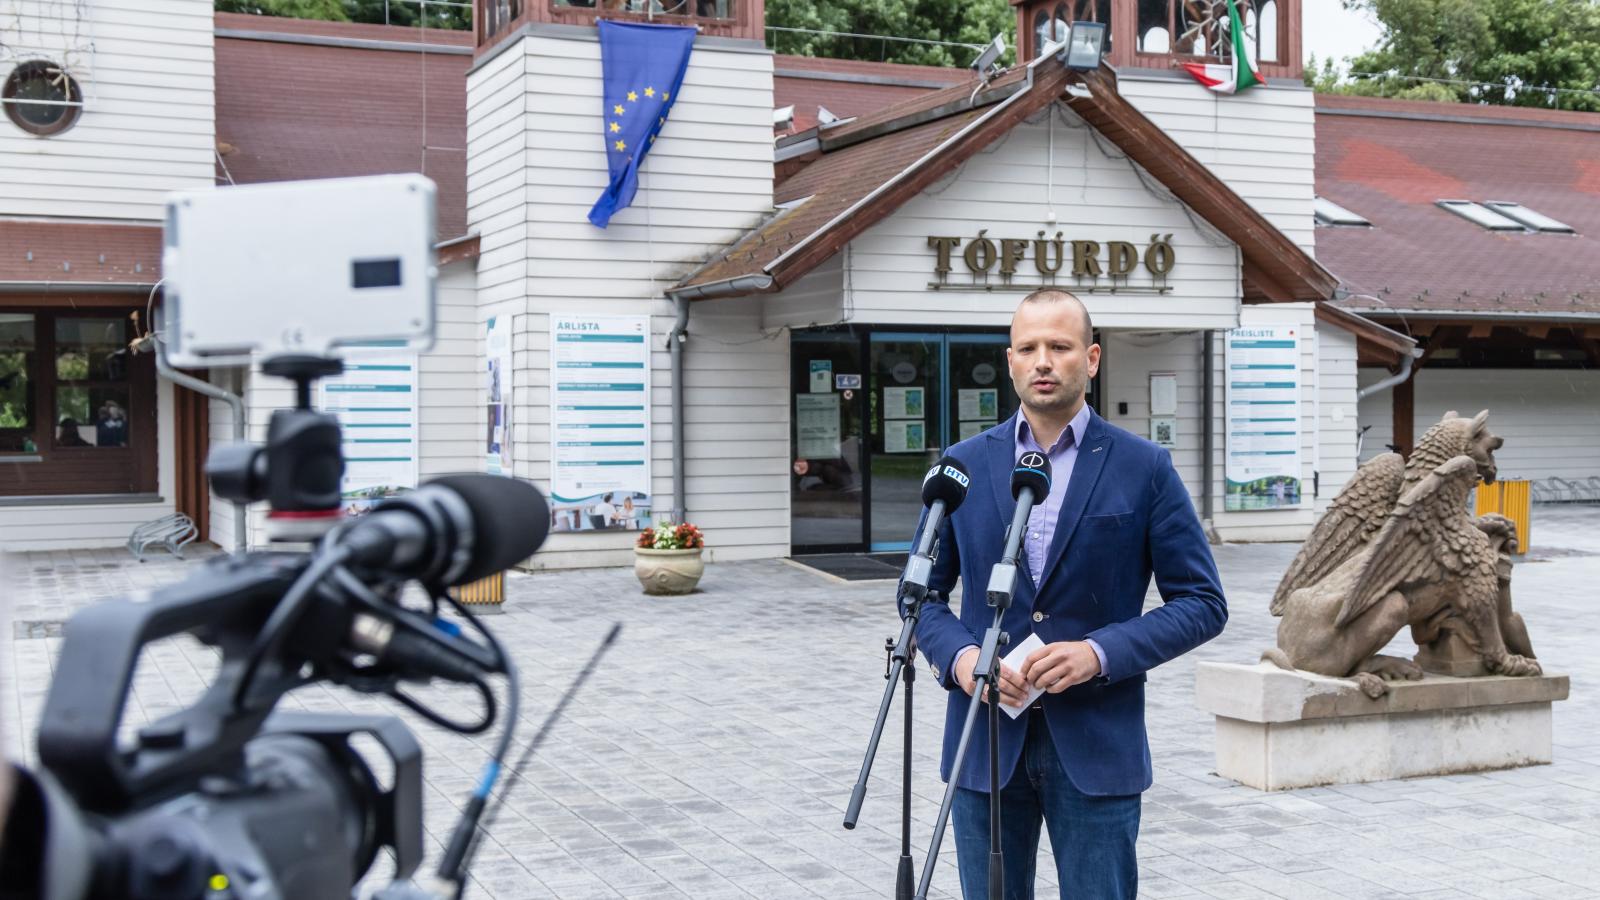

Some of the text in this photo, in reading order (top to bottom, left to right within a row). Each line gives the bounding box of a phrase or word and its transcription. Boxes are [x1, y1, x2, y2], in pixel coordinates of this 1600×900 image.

[556, 321, 600, 331] ÁRLISTA
[1230, 329, 1275, 337] PREISLISTE
[946, 467, 968, 484] HTV
